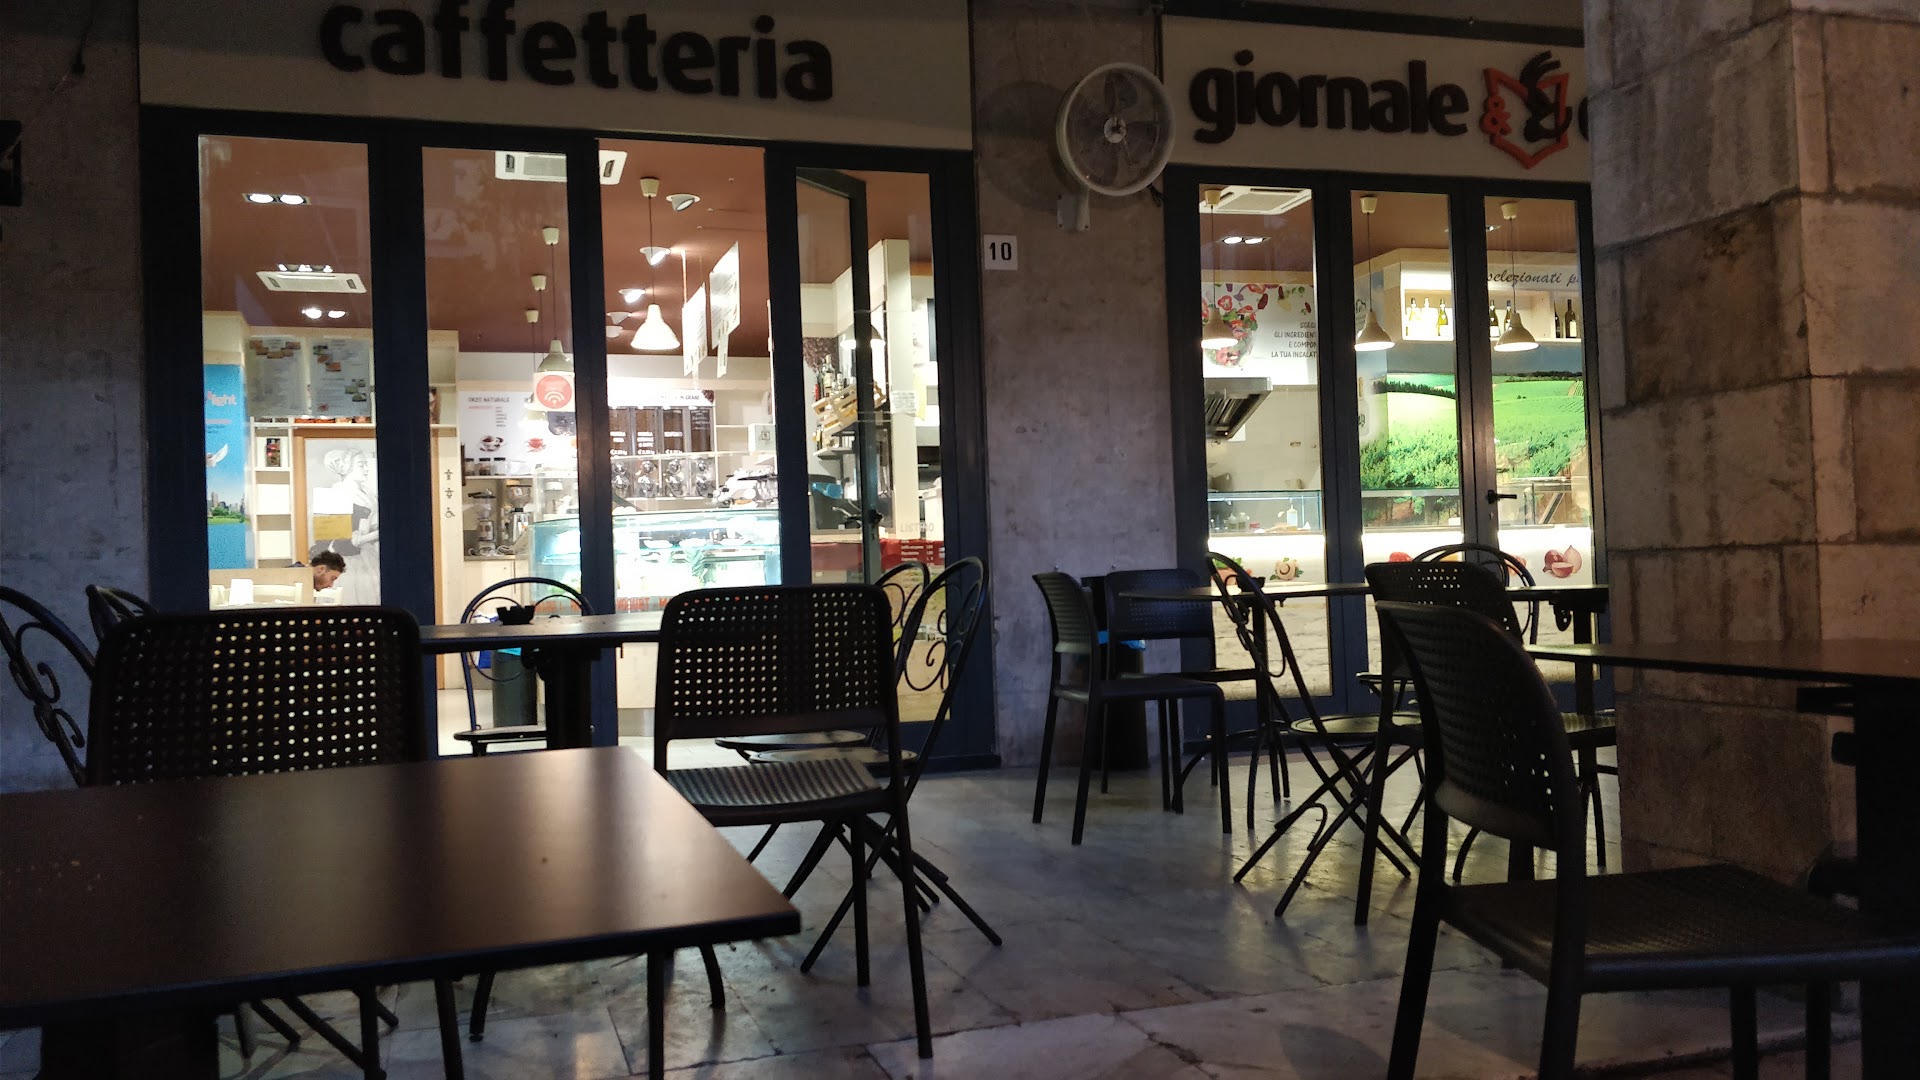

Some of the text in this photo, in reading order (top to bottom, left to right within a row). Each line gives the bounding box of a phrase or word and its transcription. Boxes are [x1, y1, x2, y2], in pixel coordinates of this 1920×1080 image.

[320, 0, 834, 101] caffetteria
[1189, 49, 1470, 143] giornale
[989, 242, 1012, 260] 10
[1487, 269, 1562, 288] selezionati
